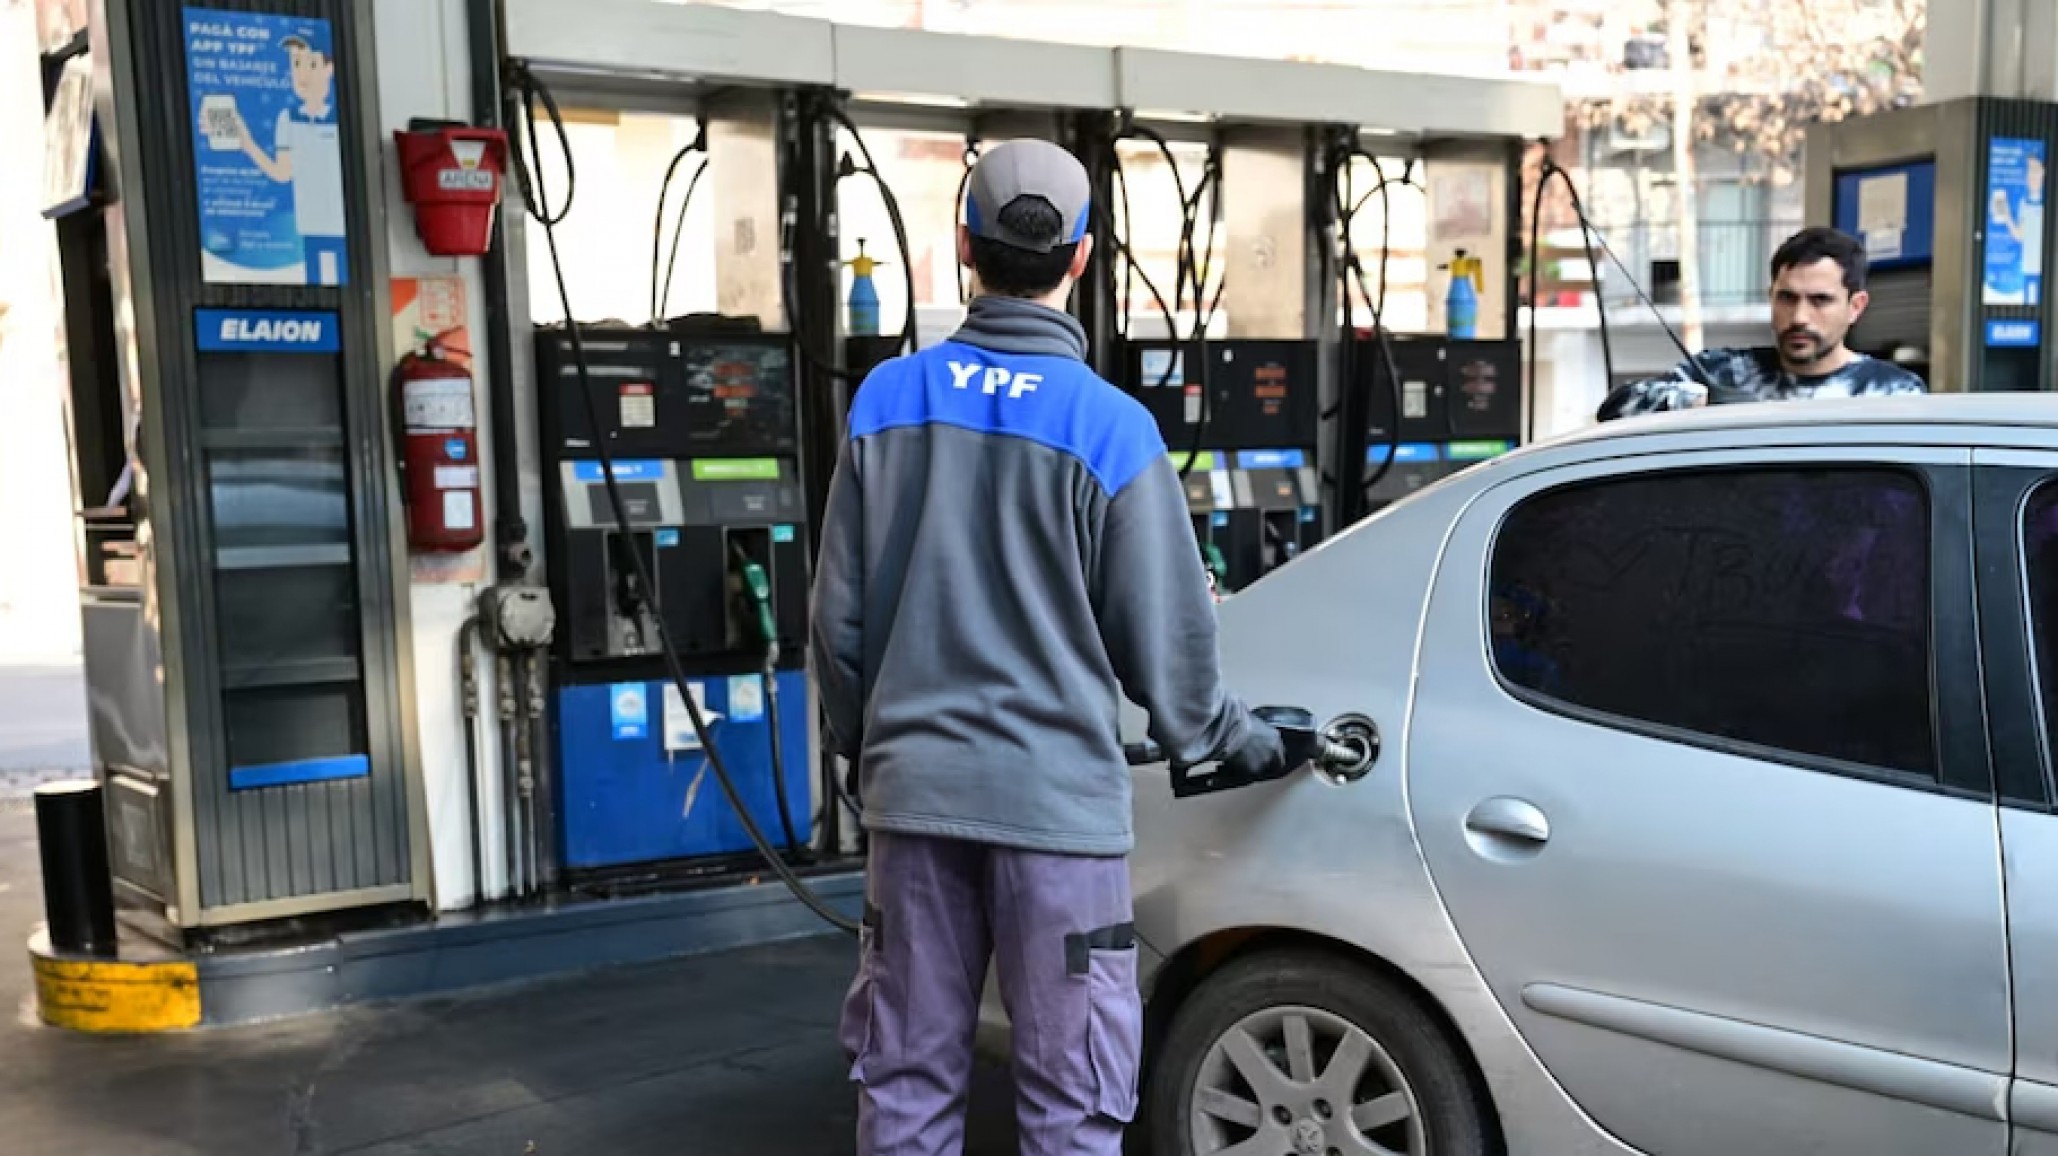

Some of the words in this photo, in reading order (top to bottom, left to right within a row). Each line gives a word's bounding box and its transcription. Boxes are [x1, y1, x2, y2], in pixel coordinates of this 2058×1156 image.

[236, 26, 270, 39] CON
[191, 39, 223, 52] APP
[228, 42, 255, 55] YPF
[220, 318, 321, 342] ELAION
[946, 360, 1044, 399] YPF
